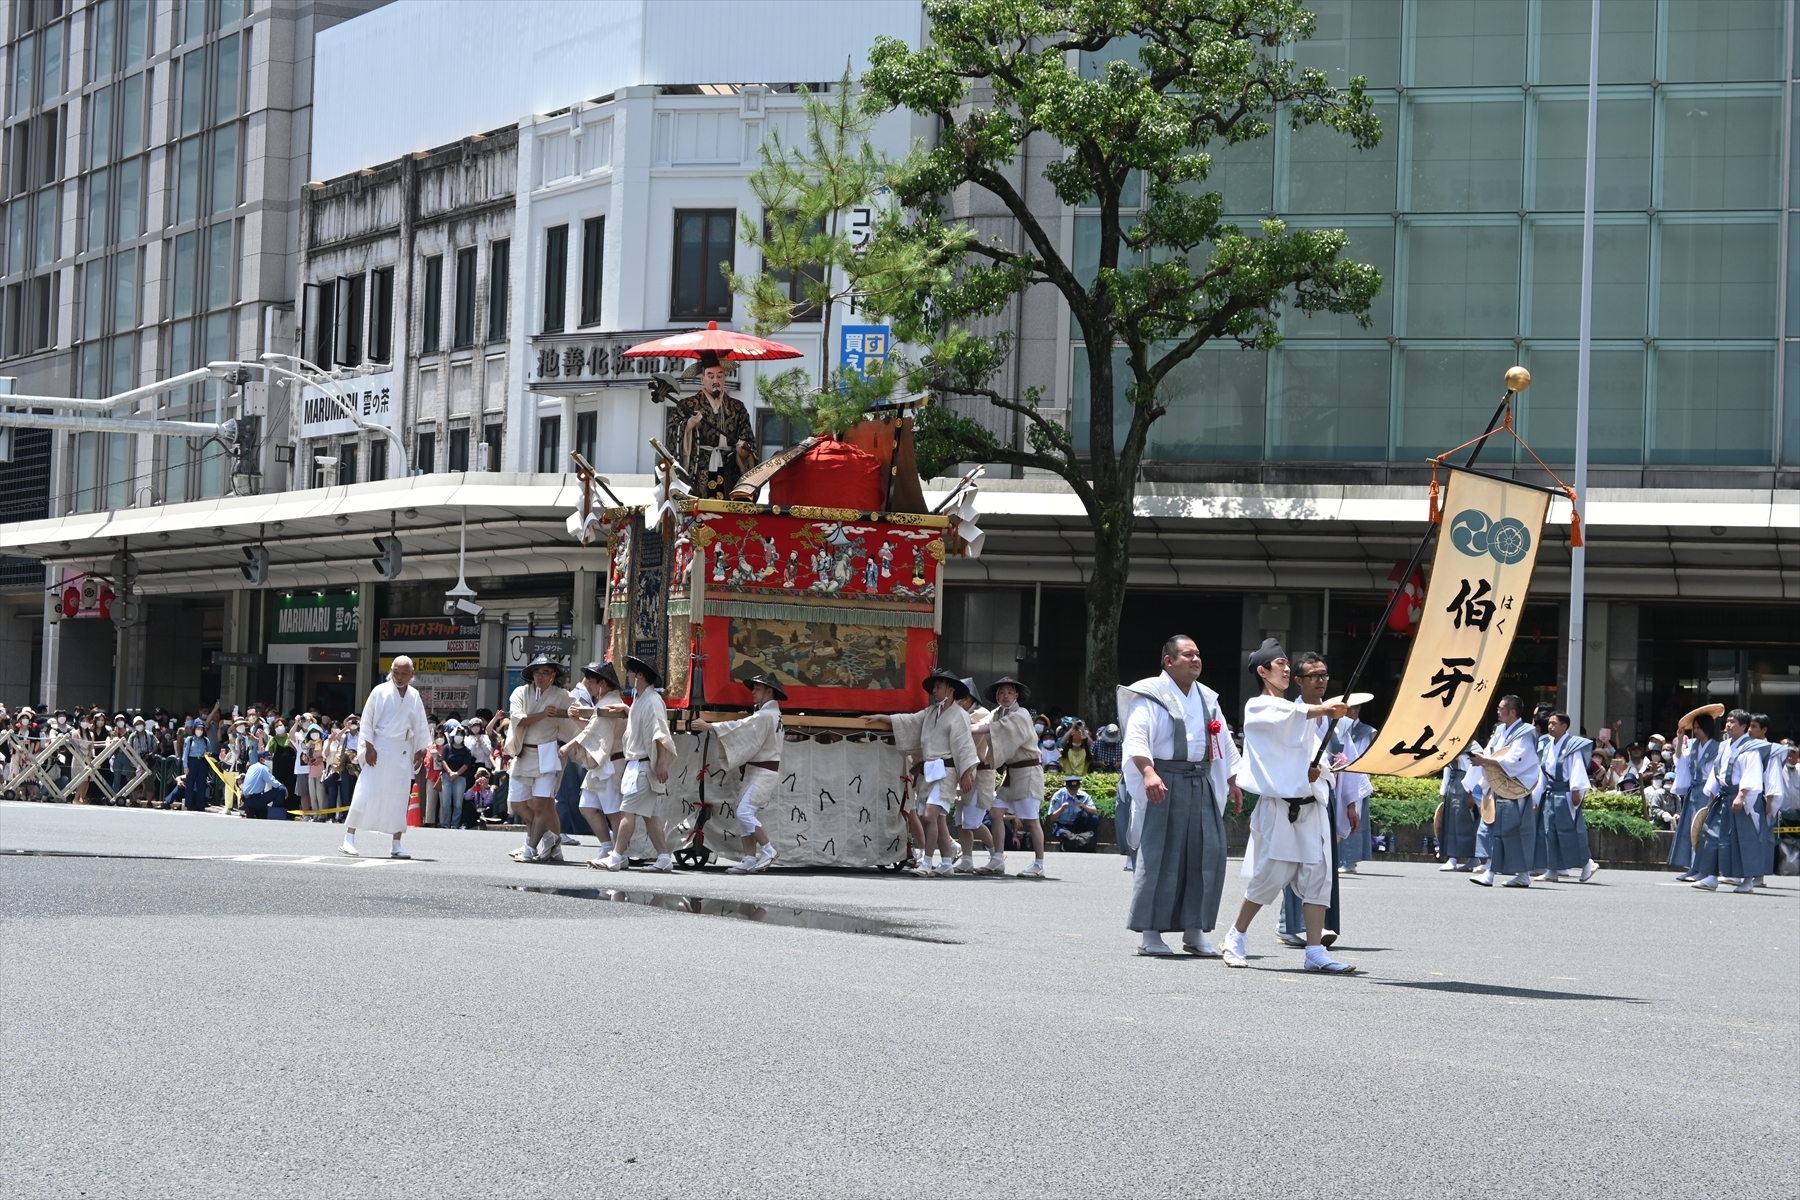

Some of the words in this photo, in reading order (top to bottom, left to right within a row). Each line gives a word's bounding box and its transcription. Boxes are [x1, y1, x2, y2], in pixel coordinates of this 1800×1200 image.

[304, 392, 358, 425] MARUMARU
[363, 387, 390, 416] 雲の茶
[279, 607, 331, 633] MARUMARU
[335, 605, 360, 631] 雲の茶
[447, 640, 465, 651] ACCESS
[534, 644, 563, 652] コンタクト
[453, 660, 480, 670] Commission
[1390, 578, 1498, 761] 伯牙山
